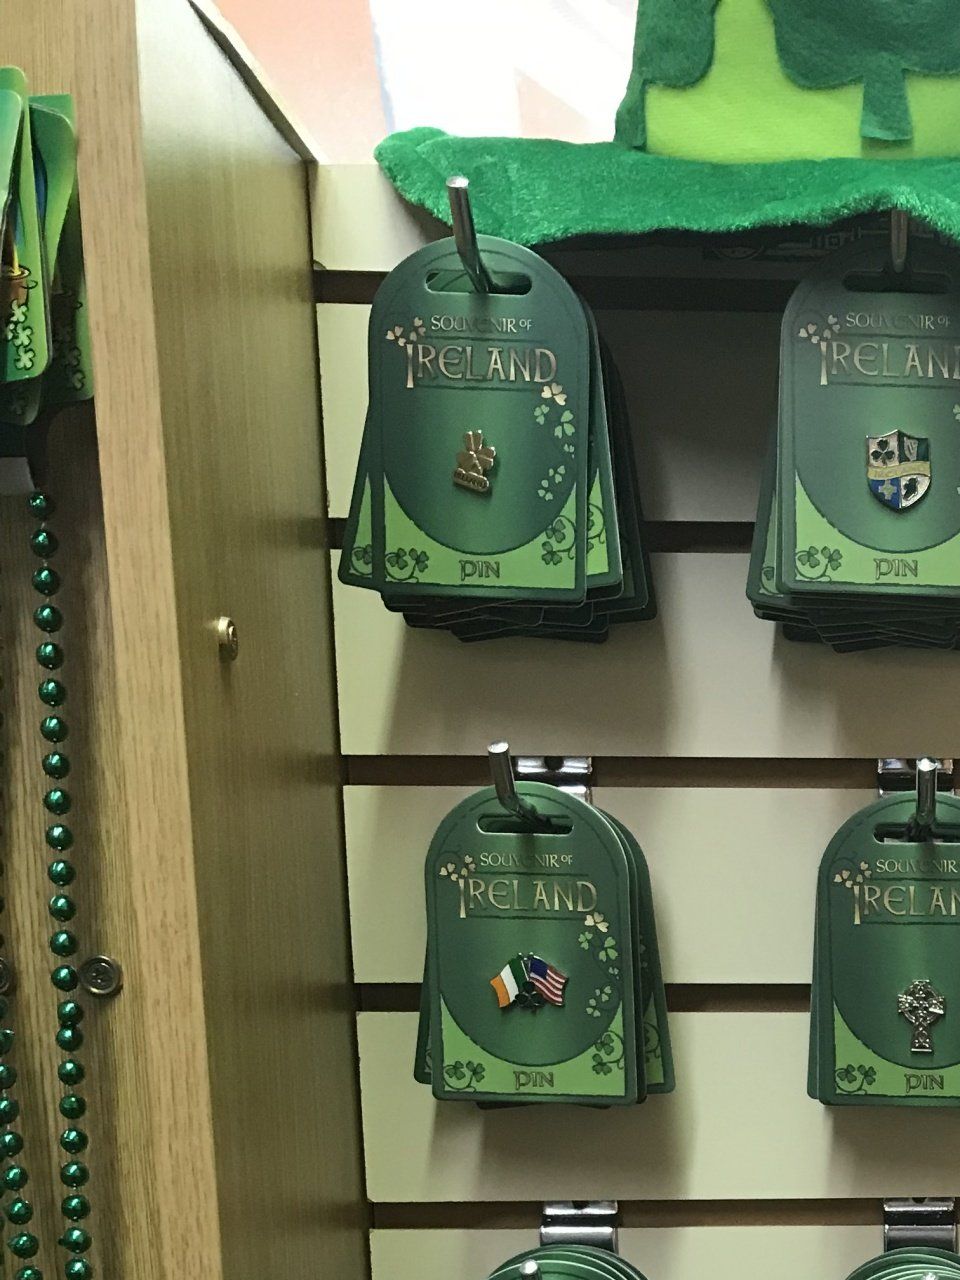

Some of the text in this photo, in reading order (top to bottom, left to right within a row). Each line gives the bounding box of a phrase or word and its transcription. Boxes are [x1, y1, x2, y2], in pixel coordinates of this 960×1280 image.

[405, 344, 557, 388] IRELAND
[459, 560, 500, 581] PIN
[874, 558, 918, 580] PIN
[458, 878, 597, 918] IRELAND
[513, 1070, 554, 1090] PIN
[904, 1073, 944, 1093] PIN
